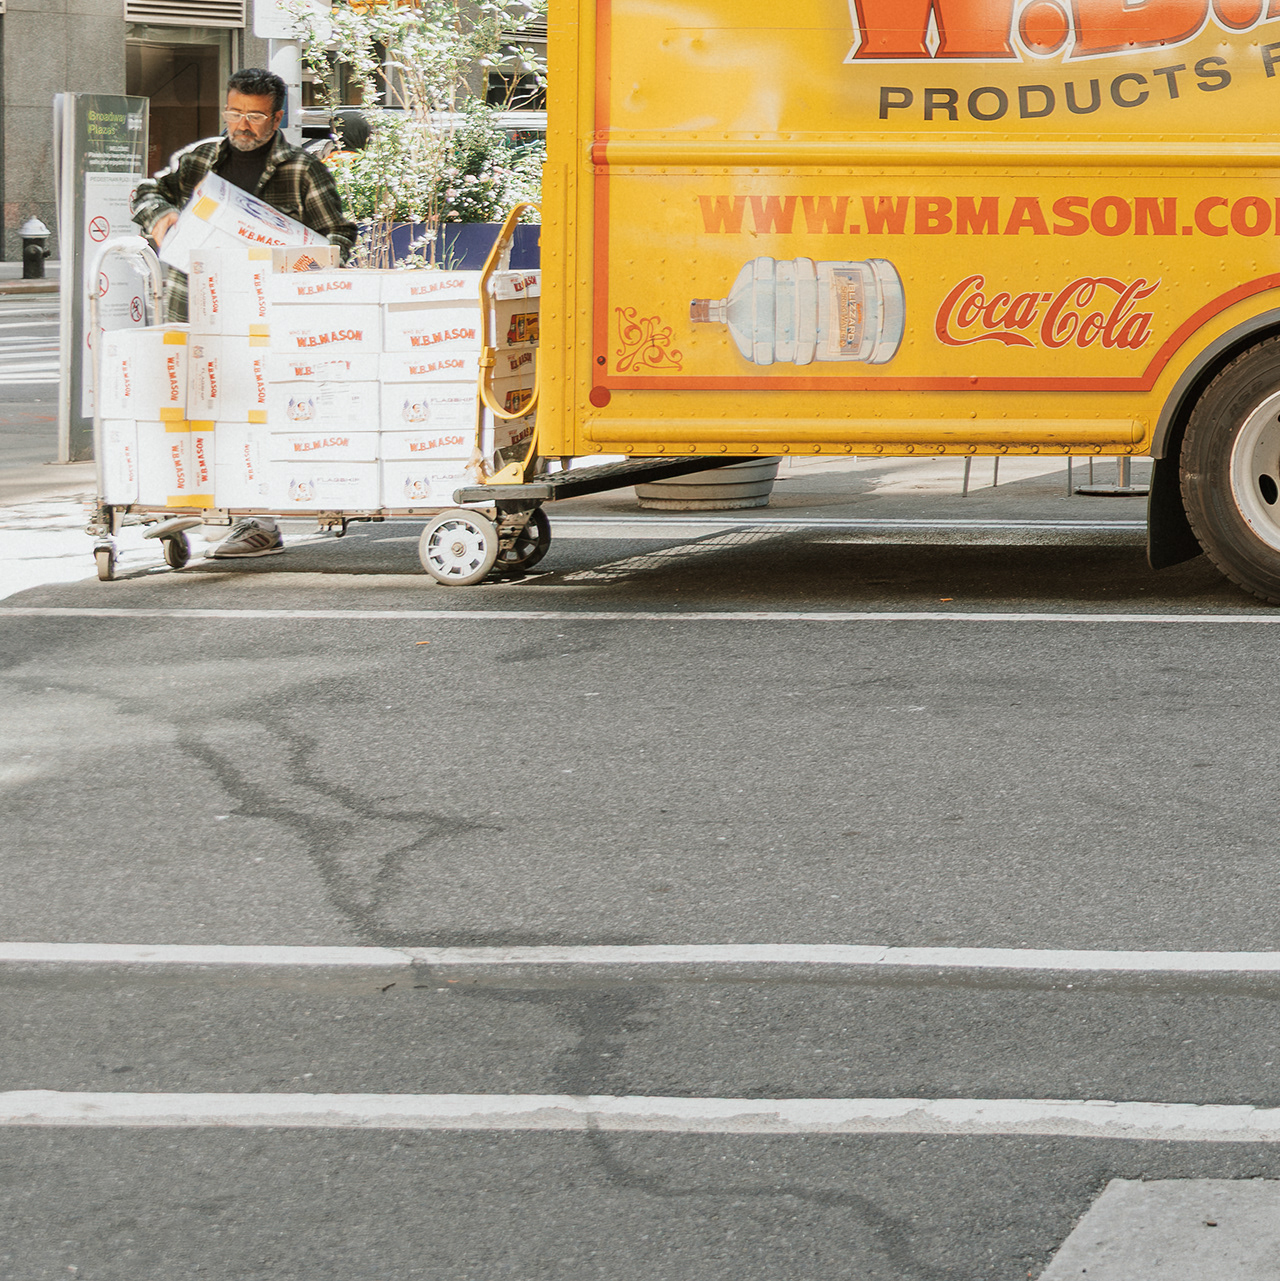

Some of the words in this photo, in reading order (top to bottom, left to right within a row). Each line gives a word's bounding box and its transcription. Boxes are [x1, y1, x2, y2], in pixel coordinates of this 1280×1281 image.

[878, 54, 1233, 121] PRODUCTS
[88, 110, 127, 124] Broadway
[88, 124, 116, 135] Plazas
[934, 273, 1162, 350] Coca-Cola
